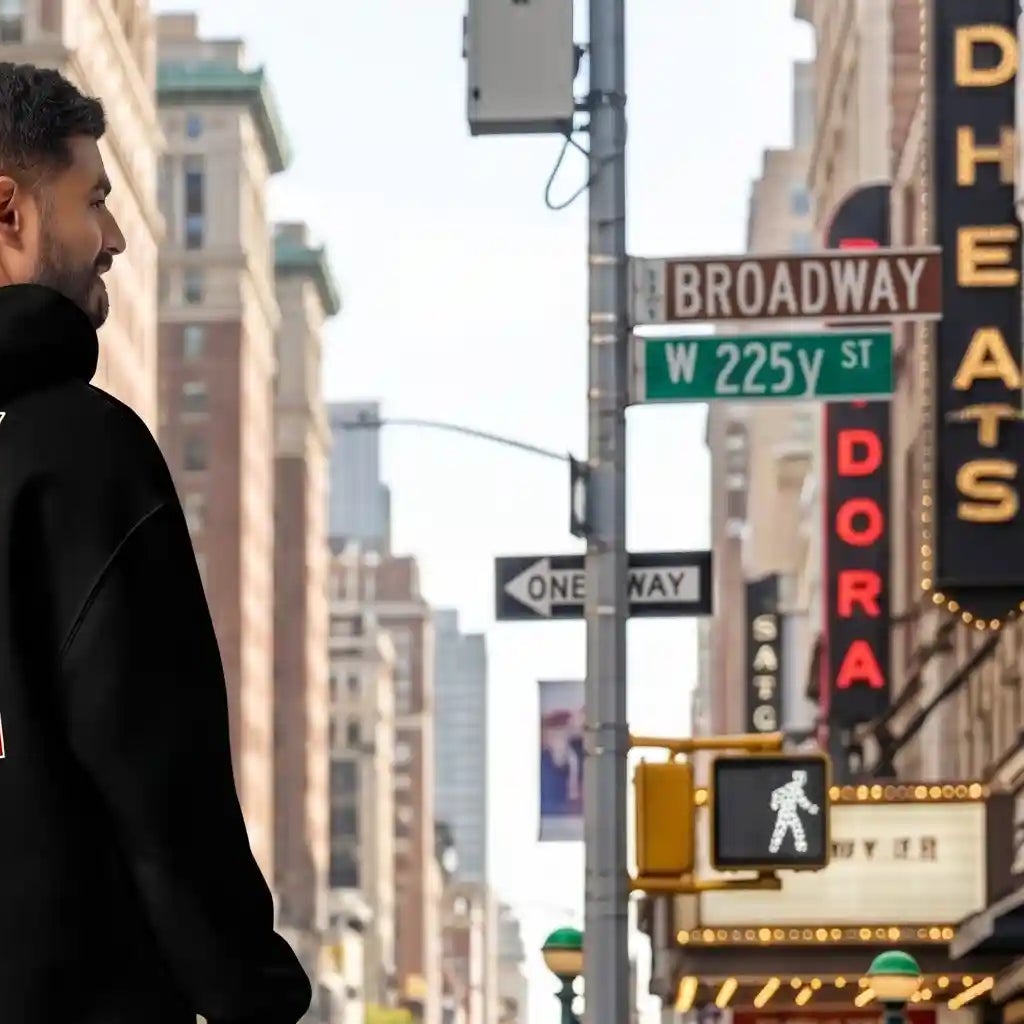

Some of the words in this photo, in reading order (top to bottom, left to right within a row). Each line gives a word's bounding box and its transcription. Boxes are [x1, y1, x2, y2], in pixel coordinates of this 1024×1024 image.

[676, 257, 927, 318] BROADWAY
[664, 342, 699, 385] W
[840, 339, 874, 370] ST
[835, 400, 885, 690] DORA
[527, 575, 586, 601] ONE
[626, 572, 685, 598] WAY
